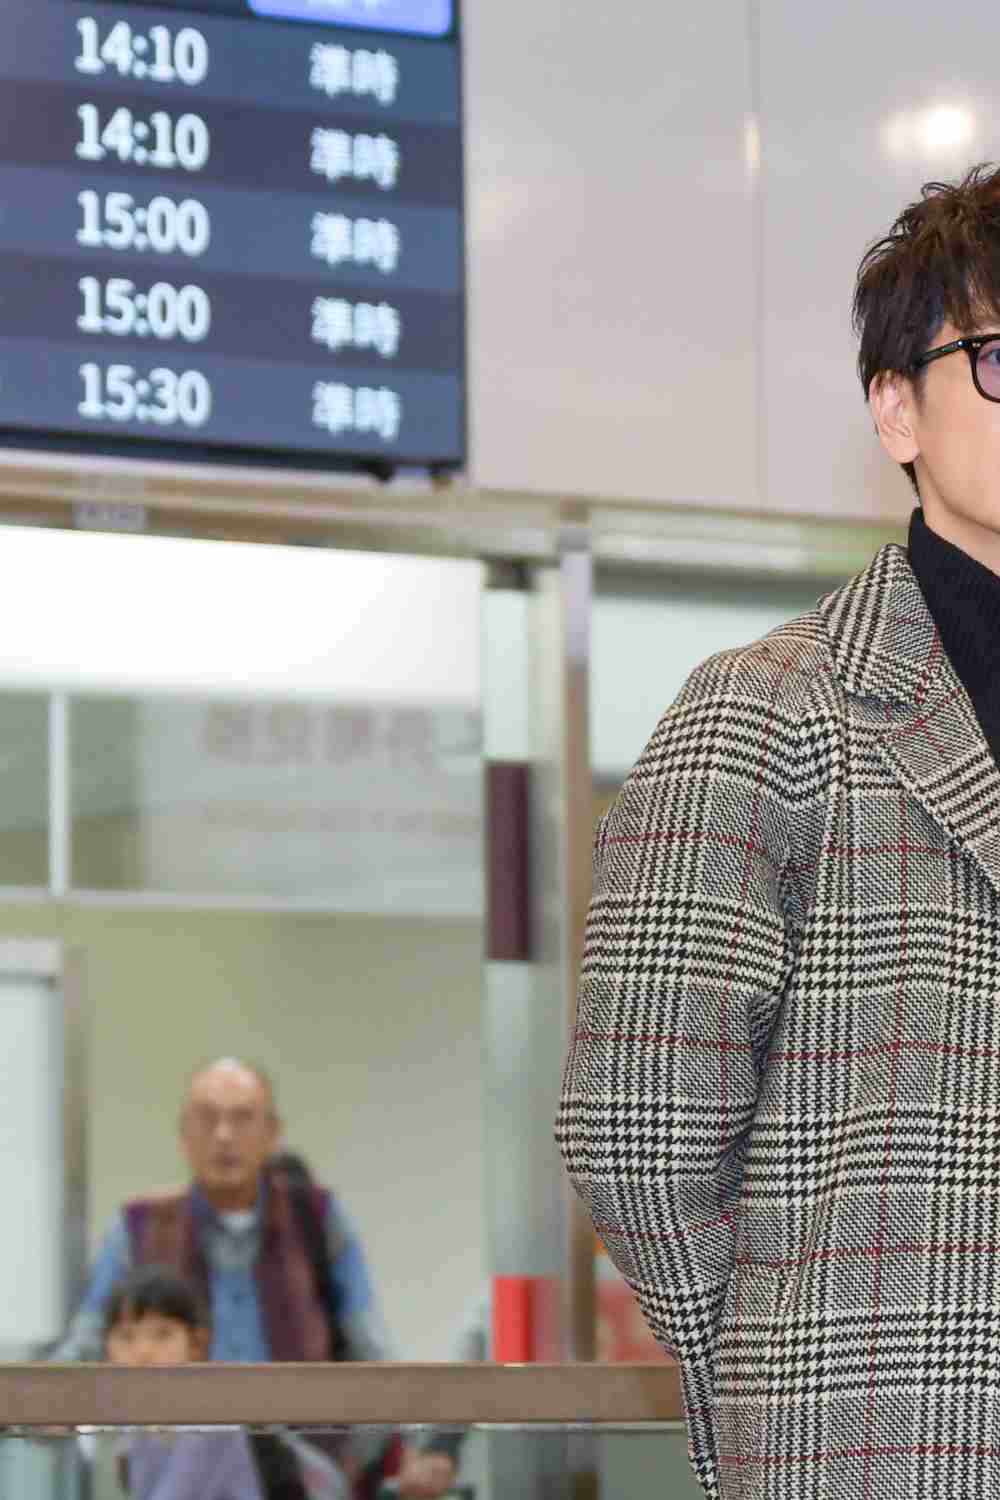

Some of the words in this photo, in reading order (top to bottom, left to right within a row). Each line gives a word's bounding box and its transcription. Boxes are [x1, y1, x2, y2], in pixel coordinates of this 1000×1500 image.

[75, 17, 208, 85] 14:10
[76, 103, 209, 171] 14:10
[76, 190, 210, 256] 15:00
[77, 276, 210, 341] 15:00
[77, 362, 211, 427] 15:30
